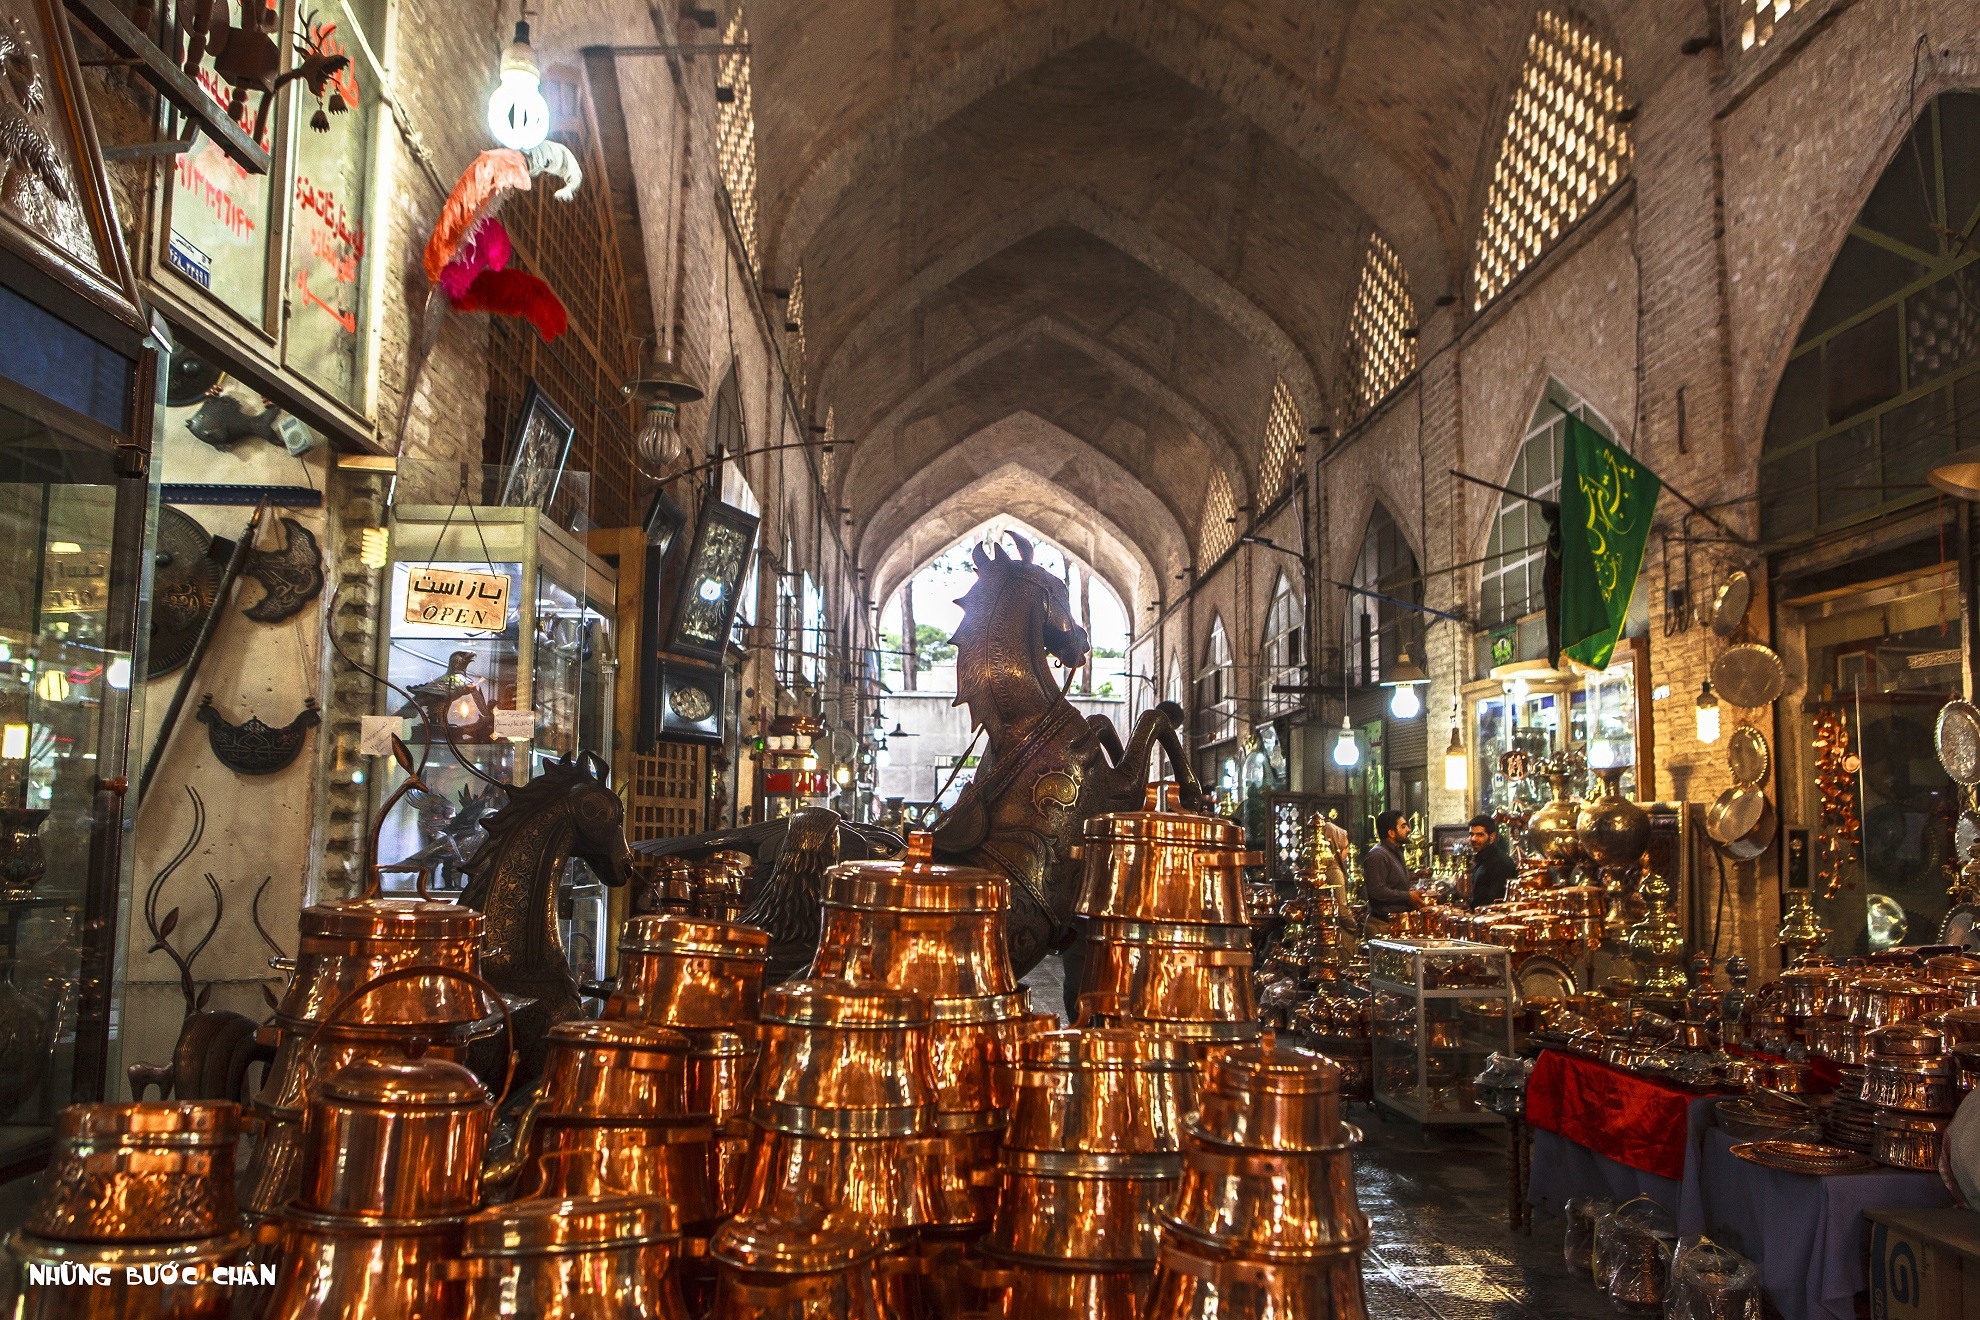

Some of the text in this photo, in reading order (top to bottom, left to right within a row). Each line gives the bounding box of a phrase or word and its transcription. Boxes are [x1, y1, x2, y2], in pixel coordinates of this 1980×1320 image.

[414, 576, 502, 605] باز است
[423, 605, 487, 624] OPEN
